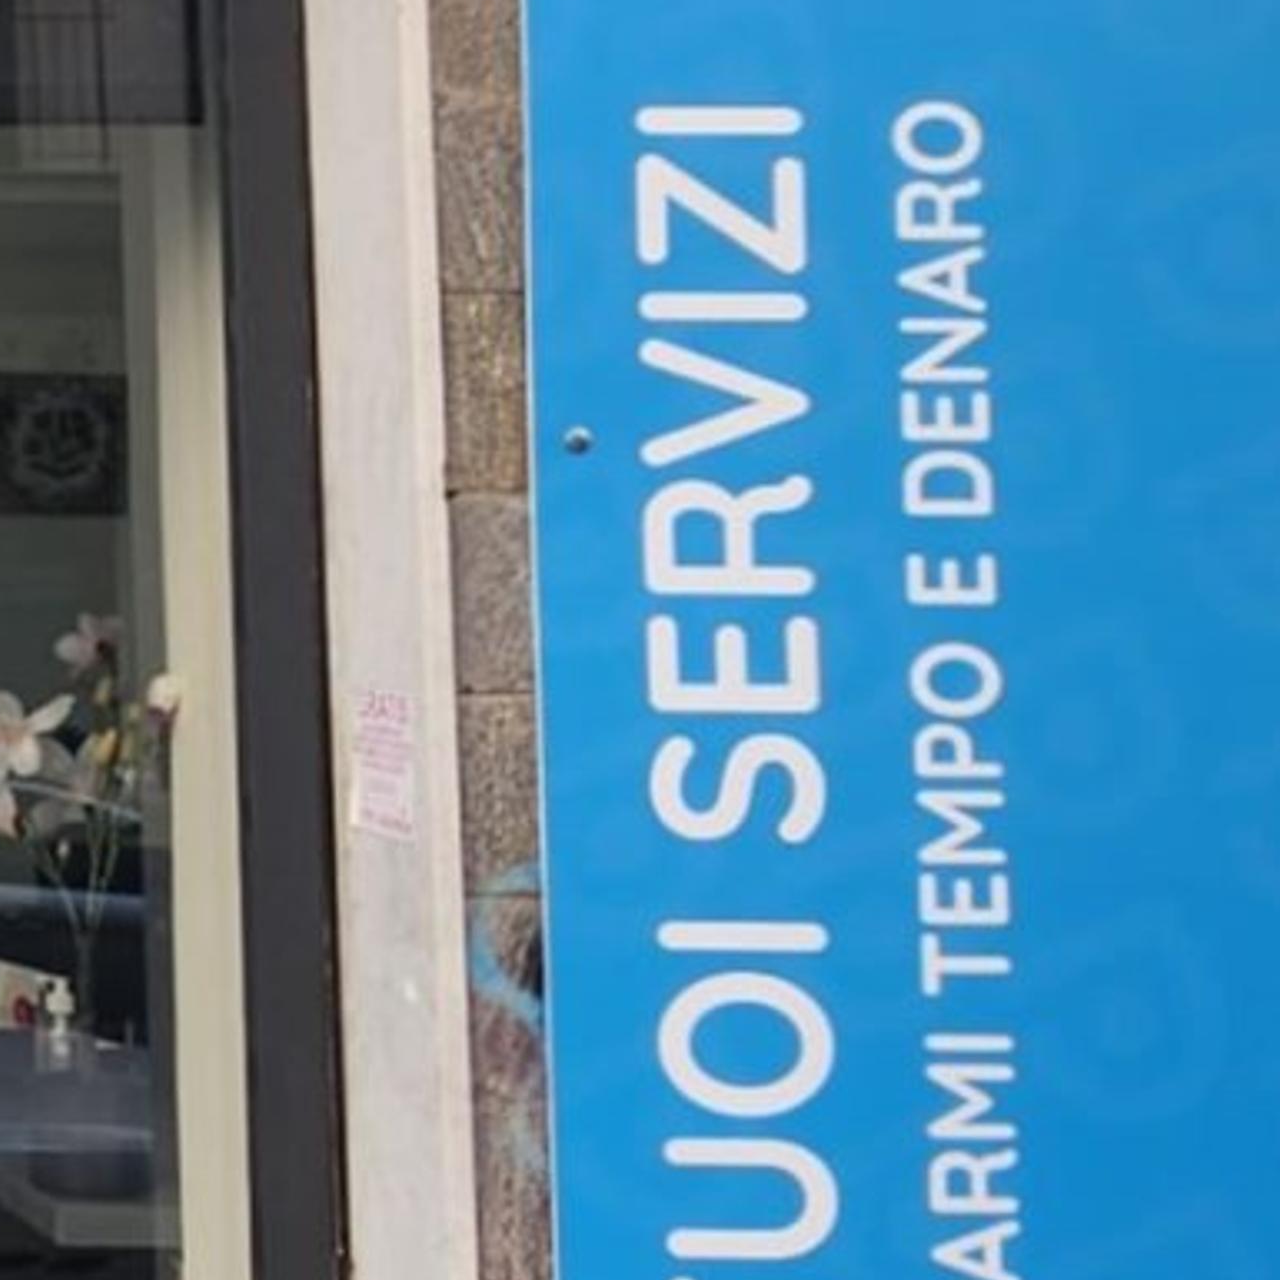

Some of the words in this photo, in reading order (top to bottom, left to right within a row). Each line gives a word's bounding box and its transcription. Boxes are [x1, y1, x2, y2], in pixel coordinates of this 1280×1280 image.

[635, 105, 827, 845] SERVIZI
[890, 100, 994, 518] DENARO
[904, 553, 1000, 606] E
[910, 641, 1013, 997] TEMPO
